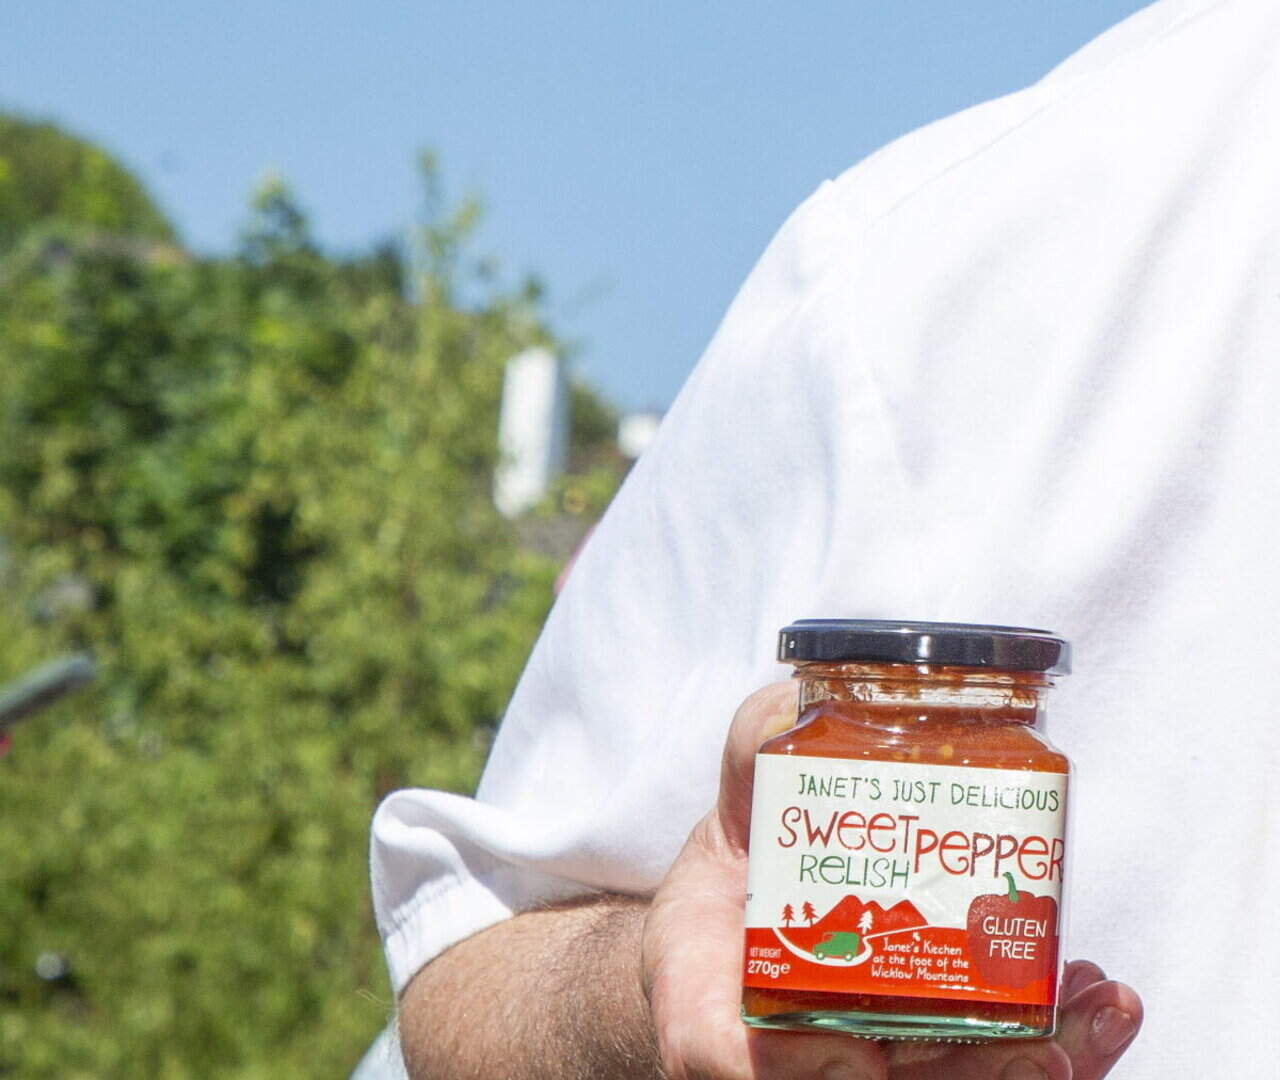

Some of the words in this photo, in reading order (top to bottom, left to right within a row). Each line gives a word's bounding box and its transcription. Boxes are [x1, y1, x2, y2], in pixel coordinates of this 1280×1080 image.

[798, 774, 882, 801] JANET'S
[892, 779, 941, 804] JUST
[951, 783, 1060, 812] DELICIOUS
[982, 915, 1048, 938] GLUTEN
[883, 937, 919, 953] Janet's
[923, 939, 963, 956] Kitchen
[989, 939, 1037, 960] FREE
[873, 956, 885, 964] at
[889, 954, 905, 965] the
[910, 955, 932, 971] foot
[936, 957, 949, 972] of
[952, 958, 969, 969] the
[871, 964, 913, 980] Wicklow
[916, 967, 969, 983] Mountains
